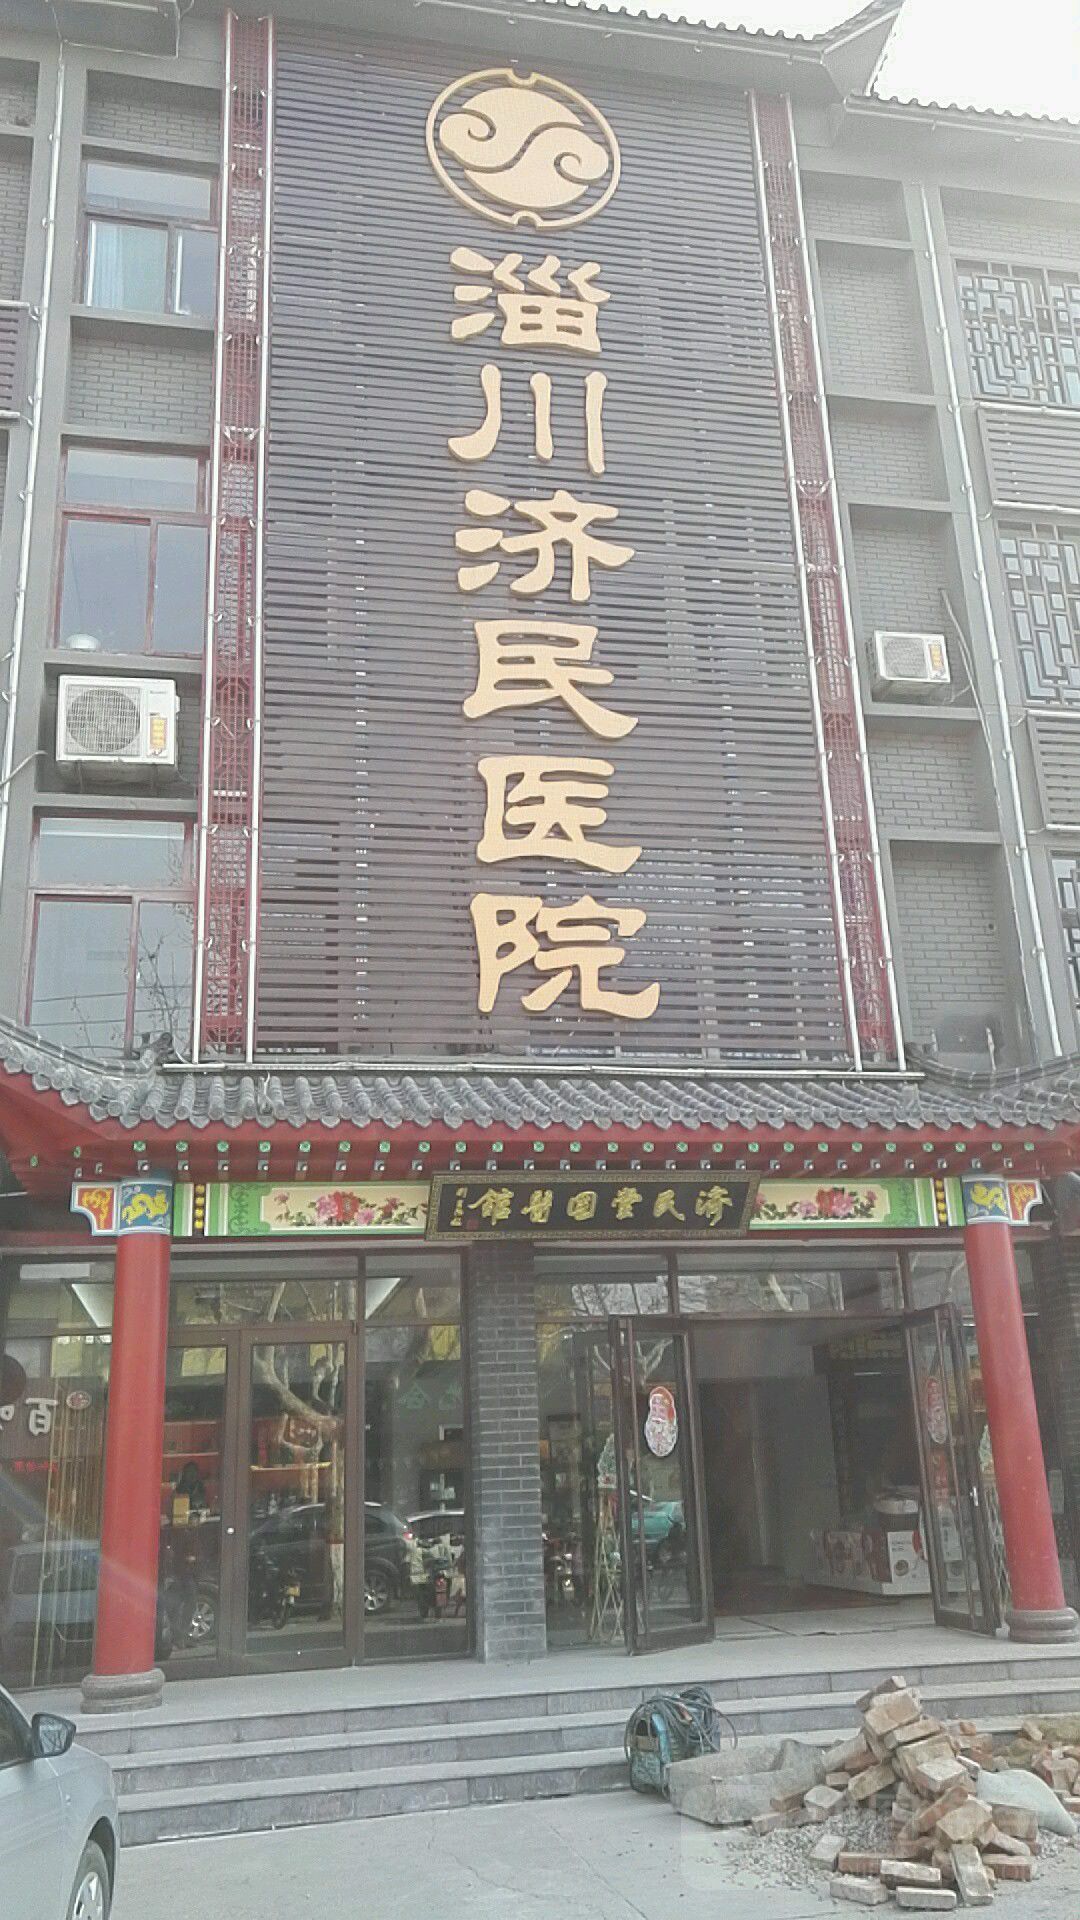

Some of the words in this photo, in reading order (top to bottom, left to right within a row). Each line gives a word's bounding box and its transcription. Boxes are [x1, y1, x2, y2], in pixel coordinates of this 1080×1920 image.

[447, 245, 661, 1019] 淄川济民医院
